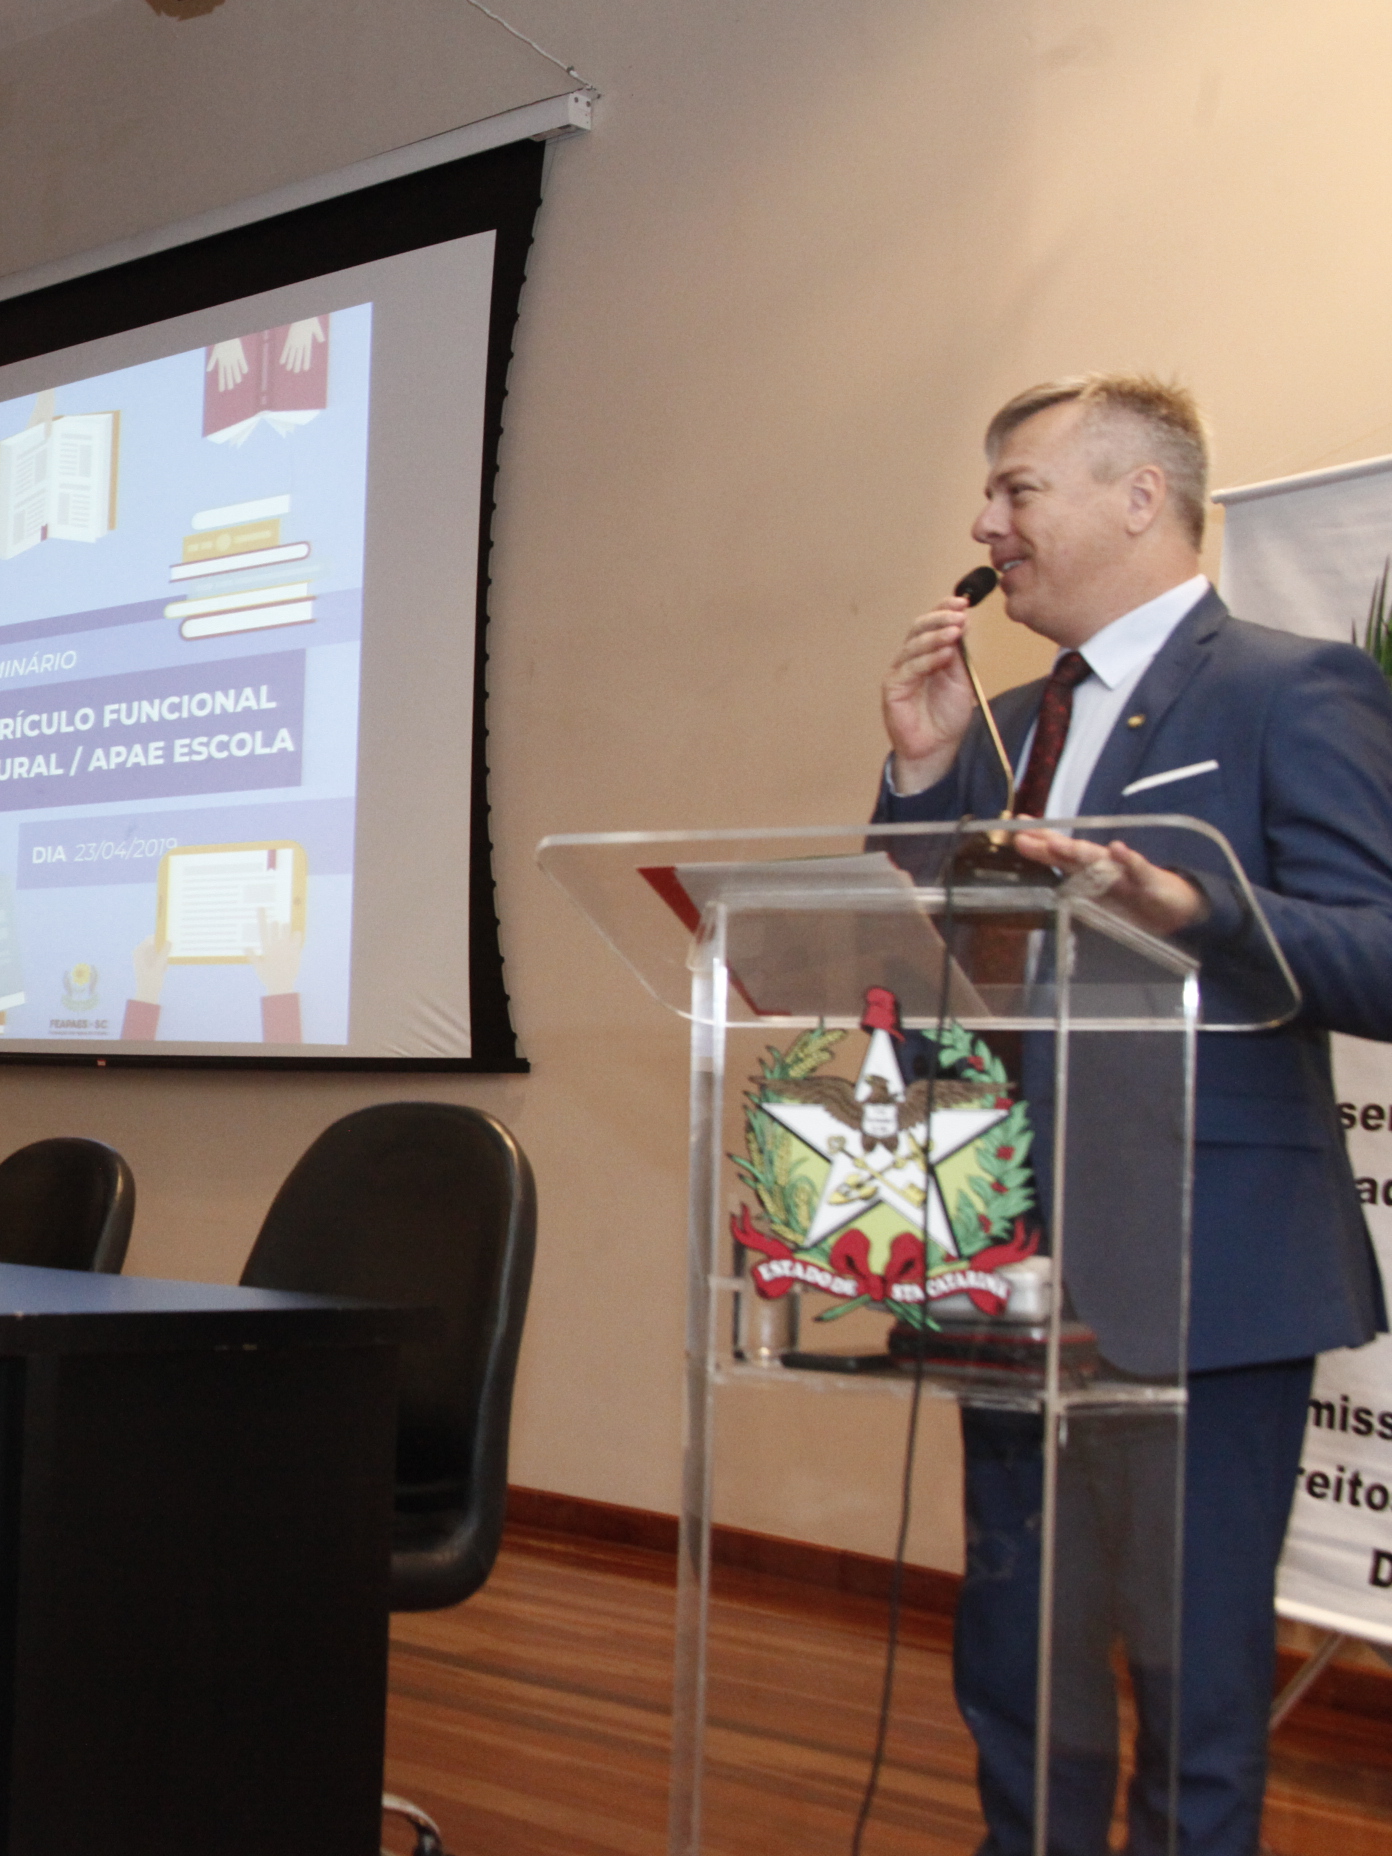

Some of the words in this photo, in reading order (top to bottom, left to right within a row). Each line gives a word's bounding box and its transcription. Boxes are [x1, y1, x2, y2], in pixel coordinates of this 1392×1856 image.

[103, 684, 277, 729] FUNCIONAL
[69, 746, 83, 777] /
[88, 741, 165, 773] APAE
[173, 728, 295, 763] ESCOLA
[32, 845, 67, 864] DIA
[73, 837, 178, 863] 23/04/2019
[1336, 1102, 1392, 1131] se
[758, 1259, 834, 1288] ESTADO
[831, 1277, 858, 1297] DE
[926, 1269, 1010, 1299] CATARINA
[1297, 1465, 1392, 1511] eito
